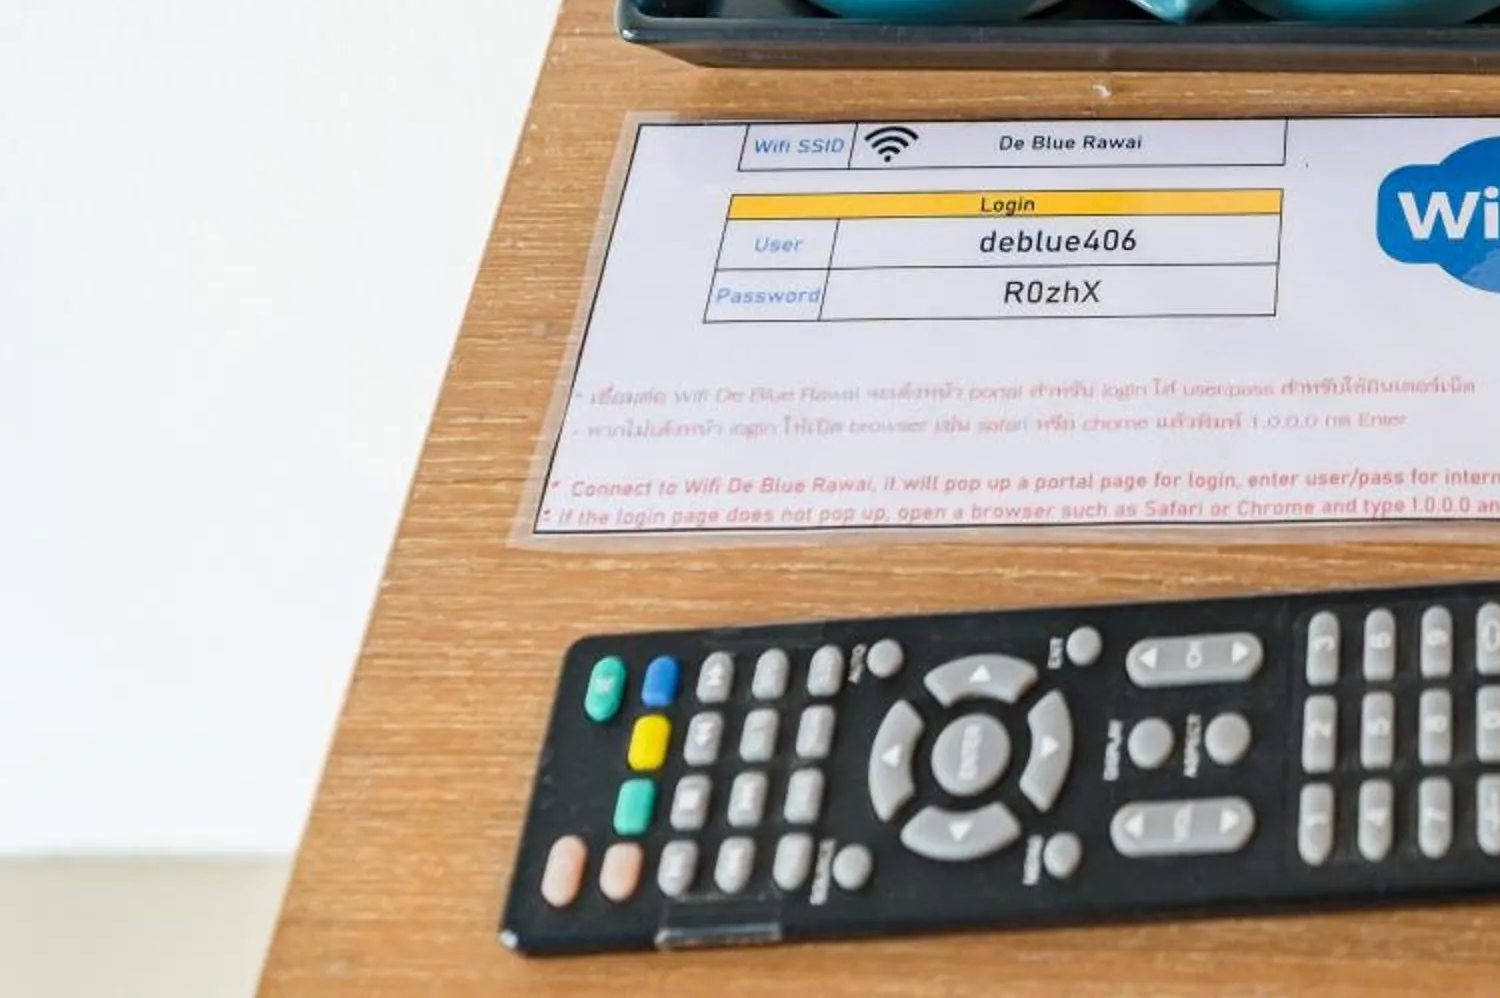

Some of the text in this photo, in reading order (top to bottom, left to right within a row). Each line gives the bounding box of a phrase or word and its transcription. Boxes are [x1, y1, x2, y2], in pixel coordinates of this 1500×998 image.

[754, 137, 846, 154] Wifi SSID
[999, 134, 1143, 152] De Blue Rawai
[980, 196, 1036, 215] Login
[754, 236, 804, 254] User
[980, 229, 1137, 254] deblue406
[717, 287, 821, 305] Password
[1004, 281, 1102, 304] R0zhX
[572, 481, 651, 497] Connect
[660, 481, 676, 496] to
[685, 479, 721, 494] Wifi
[728, 479, 753, 494] De
[760, 477, 804, 494] Blue
[884, 476, 897, 492] it
[903, 475, 939, 492] will
[945, 477, 980, 493] pop
[988, 476, 1011, 492] up
[1018, 477, 1029, 489] a
[1034, 472, 1093, 492] portal
[1100, 475, 1147, 493] page
[1154, 471, 1181, 487] for
[1248, 472, 1300, 487] enter
[1306, 468, 1405, 489] user/pass
[1411, 468, 1437, 484] for
[559, 508, 573, 524] If
[578, 508, 608, 523] the
[617, 507, 665, 526] login
[671, 510, 720, 526] page
[726, 507, 774, 523] does
[781, 506, 812, 521] not
[819, 510, 856, 525] pop
[899, 507, 946, 523] open
[953, 507, 964, 519] a
[971, 503, 1053, 519] browser
[1061, 501, 1107, 518] such
[1115, 505, 1136, 517] as
[1146, 500, 1203, 517] Safari
[1210, 504, 1229, 516] or
[1237, 499, 1313, 516] Chrome
[1322, 498, 1357, 514] and
[1364, 501, 1406, 517] type
